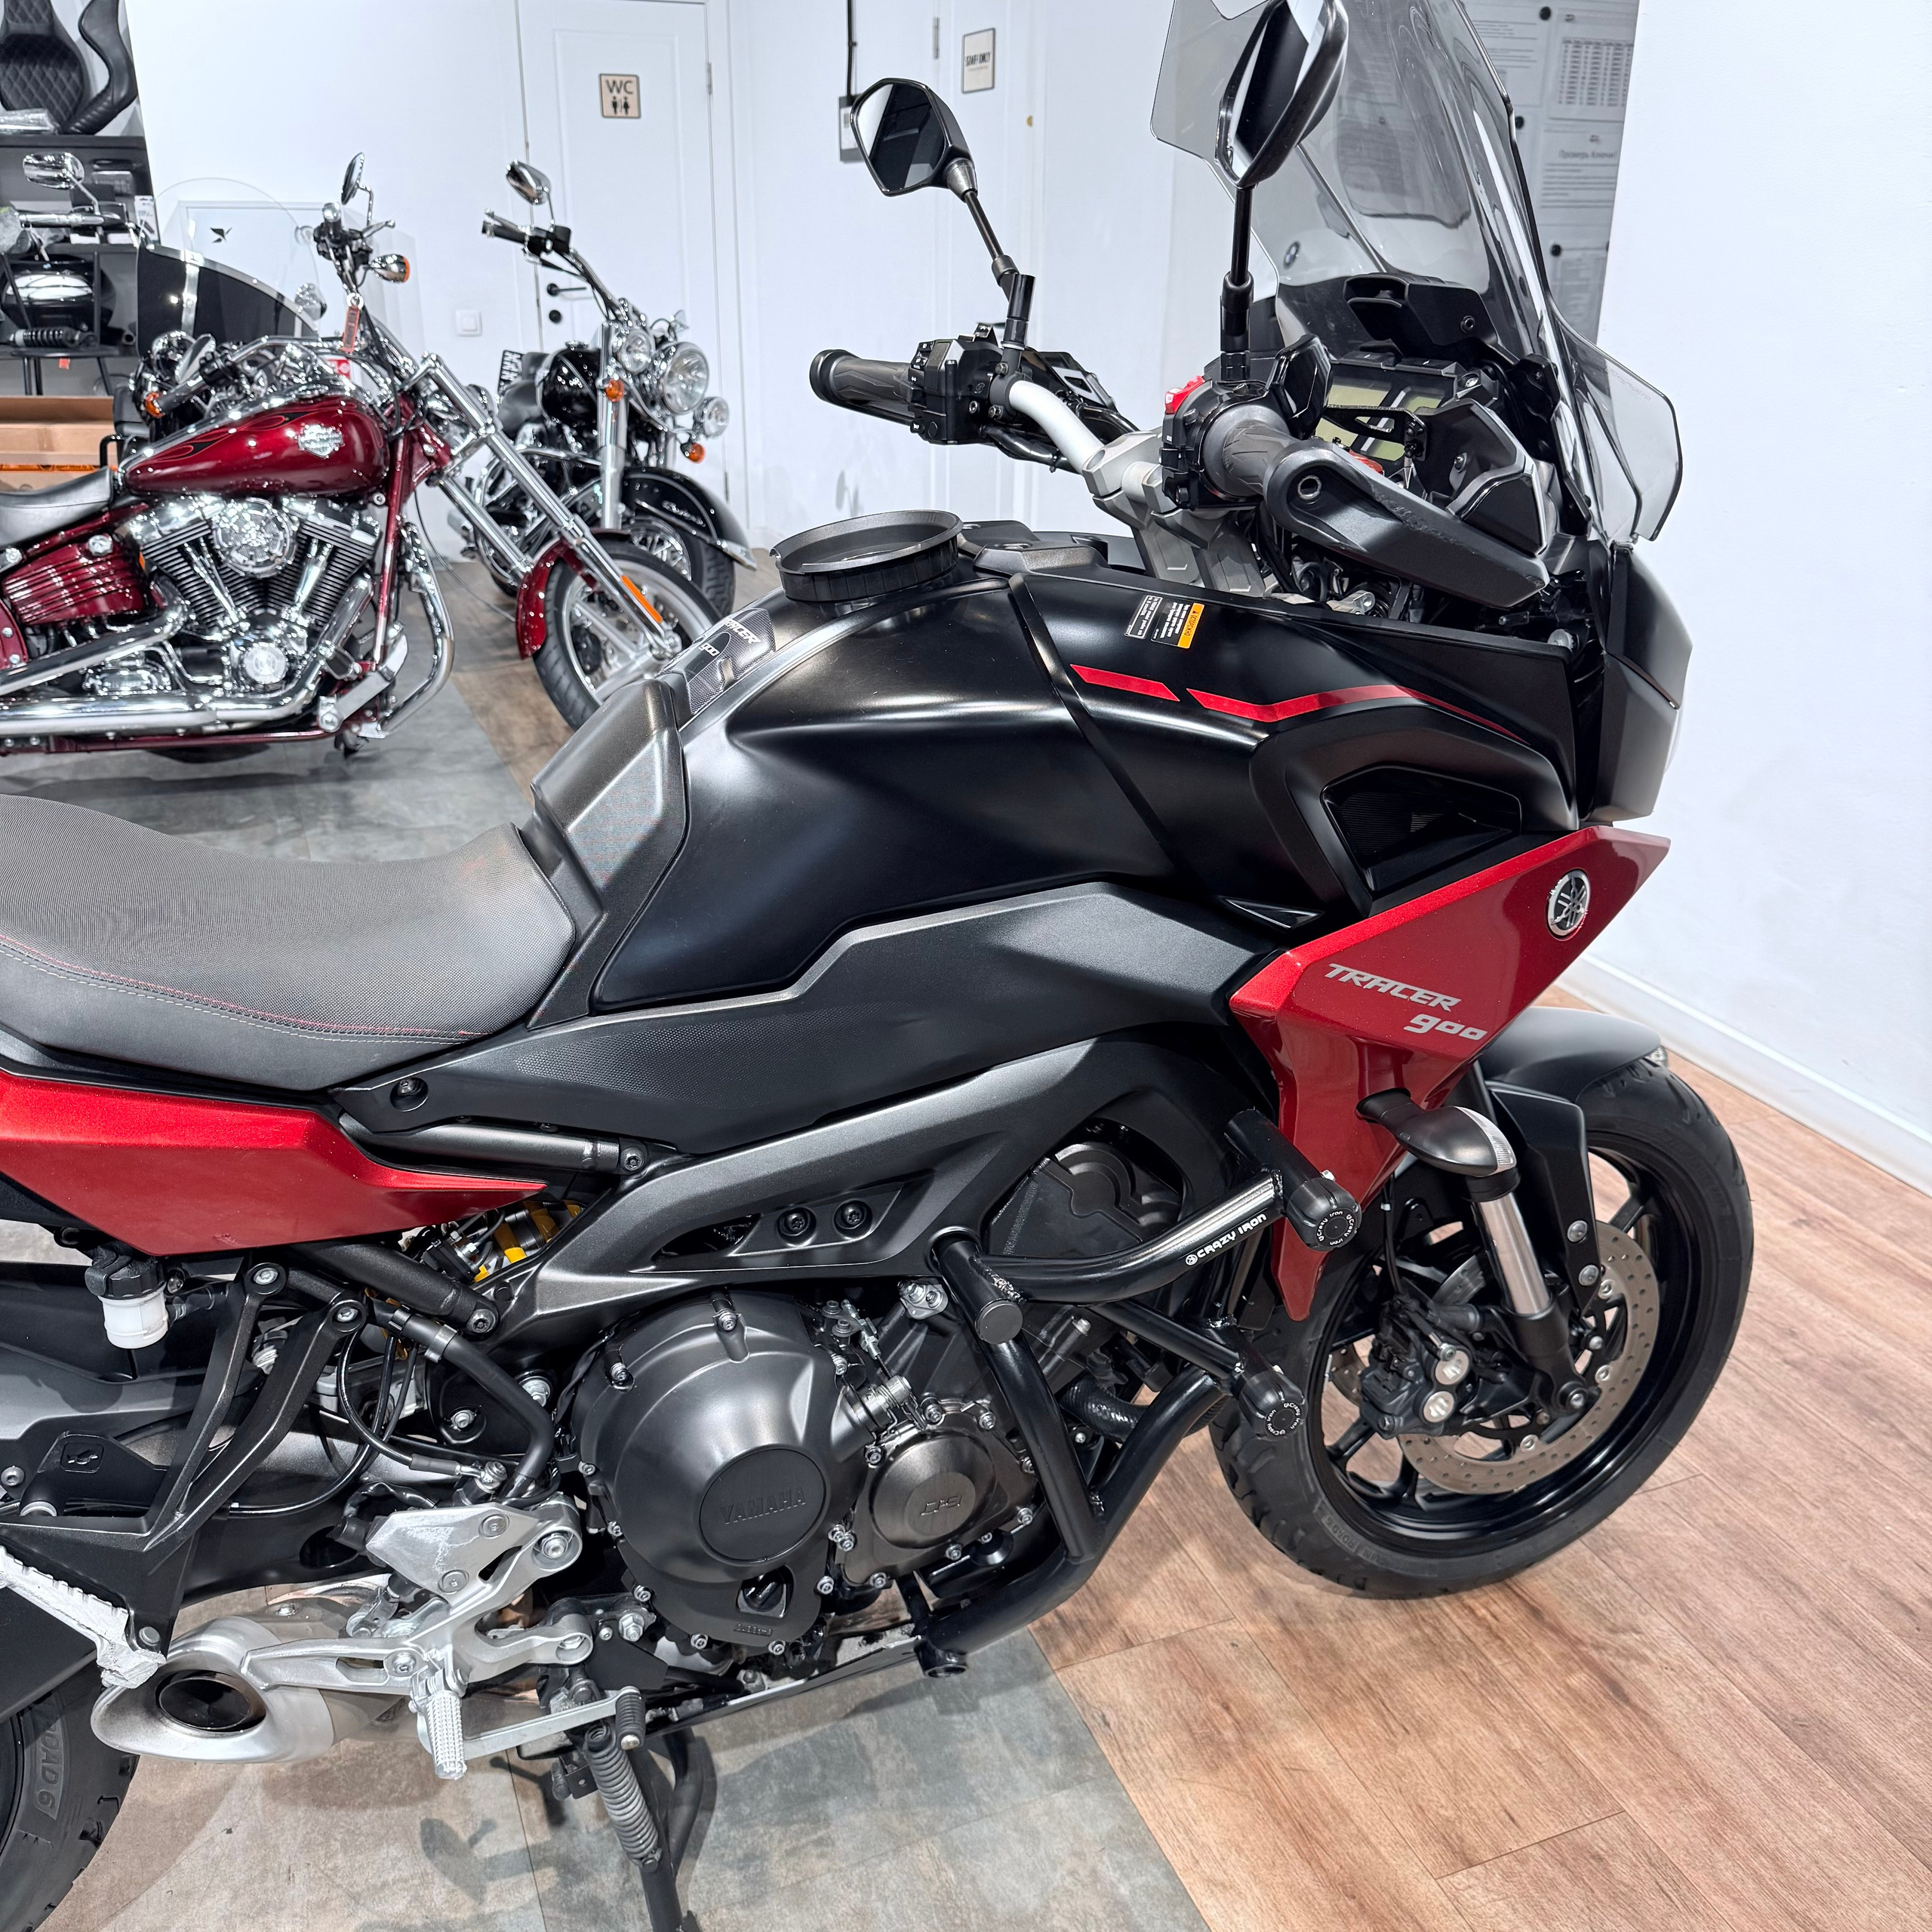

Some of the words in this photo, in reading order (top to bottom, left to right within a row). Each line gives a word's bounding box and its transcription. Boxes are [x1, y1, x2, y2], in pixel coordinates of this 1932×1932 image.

[605, 79, 633, 94] WC
[698, 642, 720, 657] 900
[1324, 964, 1462, 1012] TRACER
[1404, 1014, 1487, 1041] 900
[1197, 1230, 1236, 1258] CRAZY
[1238, 1214, 1267, 1235] IRON
[721, 1487, 806, 1524] YAMAHA
[37, 1789, 55, 1809] 6
